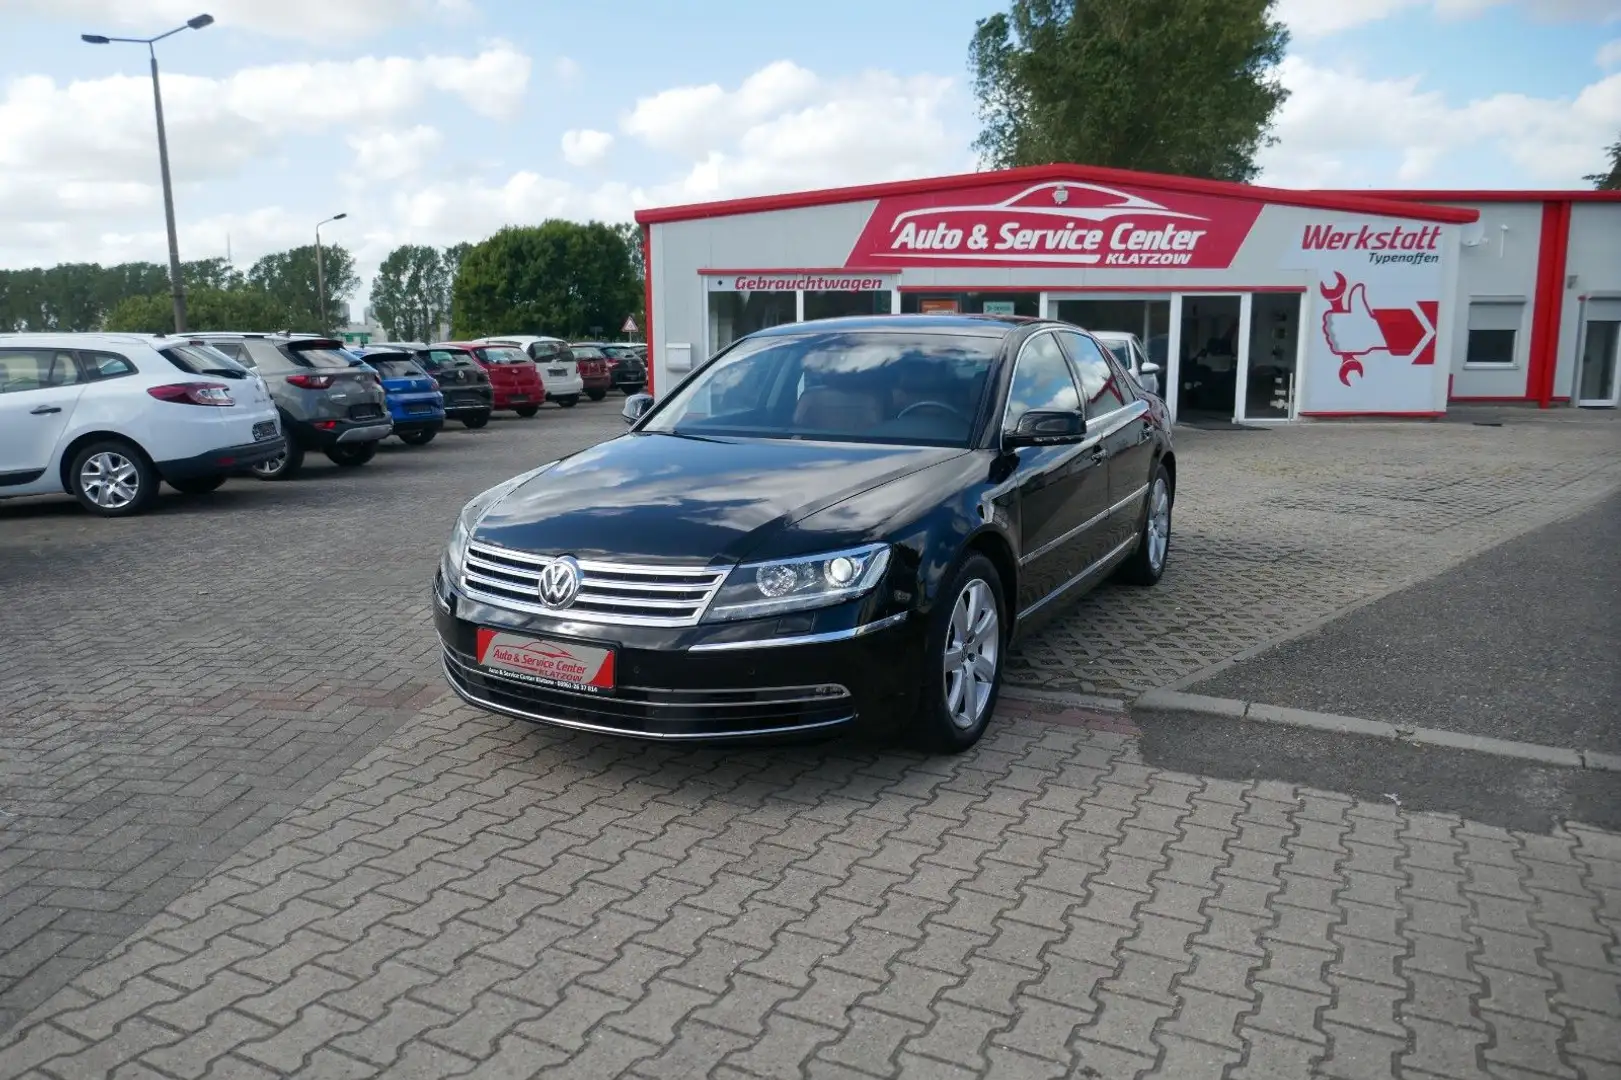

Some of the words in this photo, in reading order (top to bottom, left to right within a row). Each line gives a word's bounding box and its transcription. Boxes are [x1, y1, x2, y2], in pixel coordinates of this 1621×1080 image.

[891, 222, 963, 249] Auto
[967, 224, 988, 249] &
[995, 222, 1103, 250] Service
[1109, 223, 1207, 250] Center
[1302, 225, 1442, 250] Werkstatt
[1105, 253, 1192, 265] KLATZOW
[1369, 253, 1439, 265] Typenoffen
[735, 276, 883, 293] Gebrauchtwagen
[494, 649, 513, 661] Auto
[514, 654, 520, 663] &
[521, 655, 554, 669] Service
[556, 661, 587, 674] Center
[504, 670, 520, 678] Service
[539, 668, 583, 682] KLATZOW
